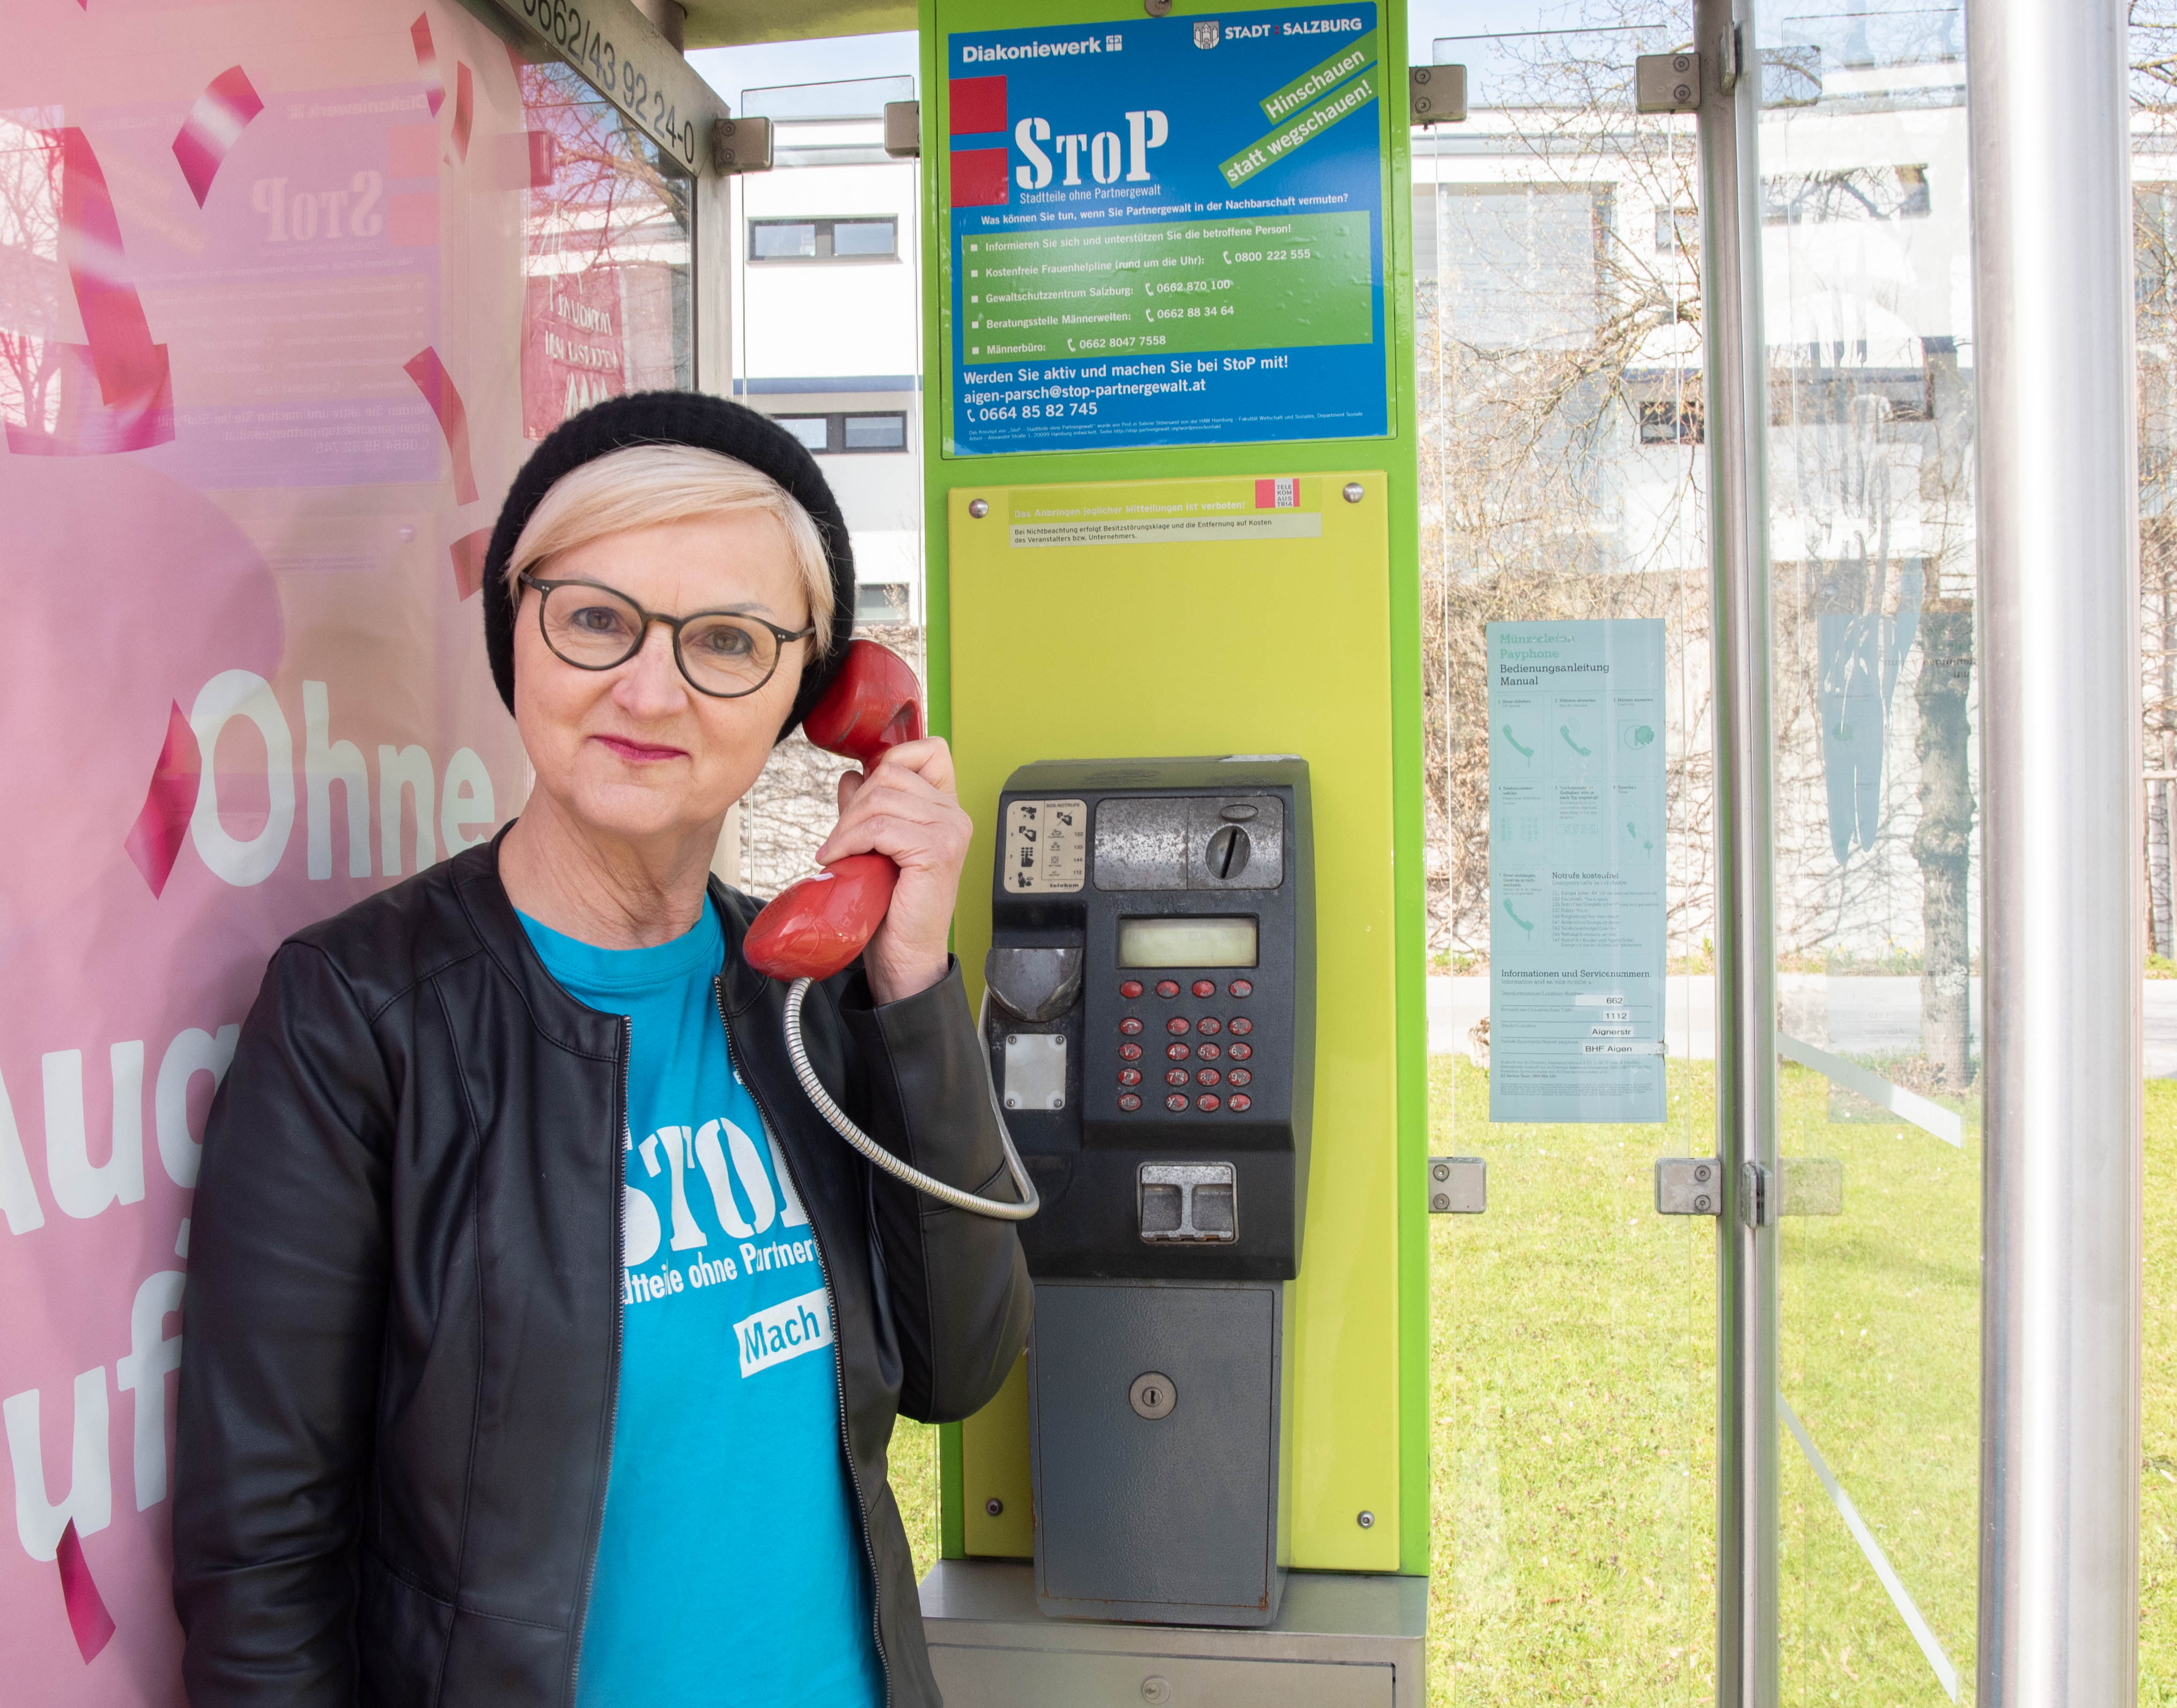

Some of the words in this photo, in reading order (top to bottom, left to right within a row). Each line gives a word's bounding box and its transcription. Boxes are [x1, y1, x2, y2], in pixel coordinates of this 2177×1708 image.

[1224, 24, 1271, 40] STADT
[1282, 17, 1362, 35] SALZBURG
[963, 36, 1102, 63] Diakoniewerk
[1266, 51, 1365, 119] Hinschauen
[623, 61, 647, 122] 92
[654, 91, 694, 164] 24-0
[1227, 149, 1266, 181] statt
[1267, 79, 1372, 155] wegschauen!
[1020, 190, 1066, 204] Stadtteile
[1069, 189, 1091, 201] ohne
[1095, 184, 1161, 199] Partnergewalt
[981, 216, 1000, 225] Was
[1002, 214, 1037, 224] können
[1039, 212, 1056, 221] Sie
[1058, 211, 1077, 221] tun,
[1080, 210, 1105, 219] wenn
[1108, 207, 1124, 217] Sie
[1126, 203, 1192, 216] Partnergewalt
[1194, 202, 1204, 212] in
[1206, 201, 1223, 211] der
[1226, 196, 1296, 210] Nachbarschaft
[1298, 193, 1348, 205] vermuten?
[986, 240, 1040, 252] Informieren
[1042, 238, 1058, 248] Sie
[1060, 236, 1080, 247] sich
[1083, 235, 1101, 245] und
[1104, 232, 1163, 245] unterstützen
[1167, 230, 1182, 240] Sie
[1185, 230, 1200, 239] die
[1203, 227, 1252, 238] betroffene
[1255, 223, 1291, 235] Person!
[986, 265, 1039, 277] Kostenfreie
[1042, 261, 1112, 273] Frauenhelpline
[1115, 258, 1141, 270] (rund
[1143, 260, 1159, 268] um
[1162, 257, 1177, 267] die
[1180, 255, 1204, 265] Uhr):
[1235, 252, 1262, 262] 0800
[1267, 250, 1287, 261] 222
[1290, 248, 1311, 260] 555
[986, 289, 1086, 303] Gewaltschutzzentrum
[1089, 286, 1133, 297] Salzburg:
[1157, 283, 1183, 293] 0662
[1187, 282, 1207, 291] 870
[1211, 279, 1230, 290] 100
[986, 315, 1059, 329] Beratungsstelle
[1061, 312, 1131, 324] Männerwelten:
[1157, 308, 1184, 319] 0662
[1187, 307, 1201, 317] 88
[1204, 306, 1217, 316] 34
[1220, 305, 1235, 315] 64
[987, 343, 1046, 354] Männerbüro:
[1079, 338, 1106, 349] 0662
[1109, 337, 1135, 347] 8047
[1139, 335, 1166, 346] 7558
[963, 370, 1013, 385] Werden
[1018, 368, 1039, 381] Sie
[1044, 366, 1076, 380] aktiv
[1081, 364, 1106, 378] und
[1112, 362, 1165, 376] machen
[1170, 360, 1192, 374] Sie
[1197, 358, 1217, 372] bei
[1223, 356, 1256, 371] StoP
[1261, 354, 1288, 369] mit!
[964, 378, 1206, 405] aigen-parsch@stop-partnergewalt.at
[979, 406, 1017, 421] 0664
[1022, 405, 1040, 418] 85
[1045, 403, 1064, 417] 82
[1069, 402, 1097, 416] 745
[1014, 510, 1031, 519] Das
[1034, 508, 1081, 517] Anbringen
[1083, 506, 1123, 516] jeglicher
[1125, 504, 1183, 514] Mitteilungen
[1186, 502, 1198, 511] ist
[1201, 500, 1245, 510] verboten!
[1103, 523, 1170, 532] Besitzstörungsklage
[1500, 648, 1560, 661] Payphone
[1500, 663, 1610, 674] Bedienungsanleitung
[1500, 677, 1538, 686] Manual
[190, 669, 495, 888] Ohne
[1552, 871, 1580, 879] Notrufe
[1501, 970, 1560, 978] Informationen
[1562, 970, 1577, 978] und
[1591, 1028, 1632, 1037] Aignerstr
[1607, 1045, 1632, 1054] Aigen
[689, 1251, 737, 1288] ohne
[739, 1239, 822, 1275] Partner
[744, 1305, 820, 1365] Mach
